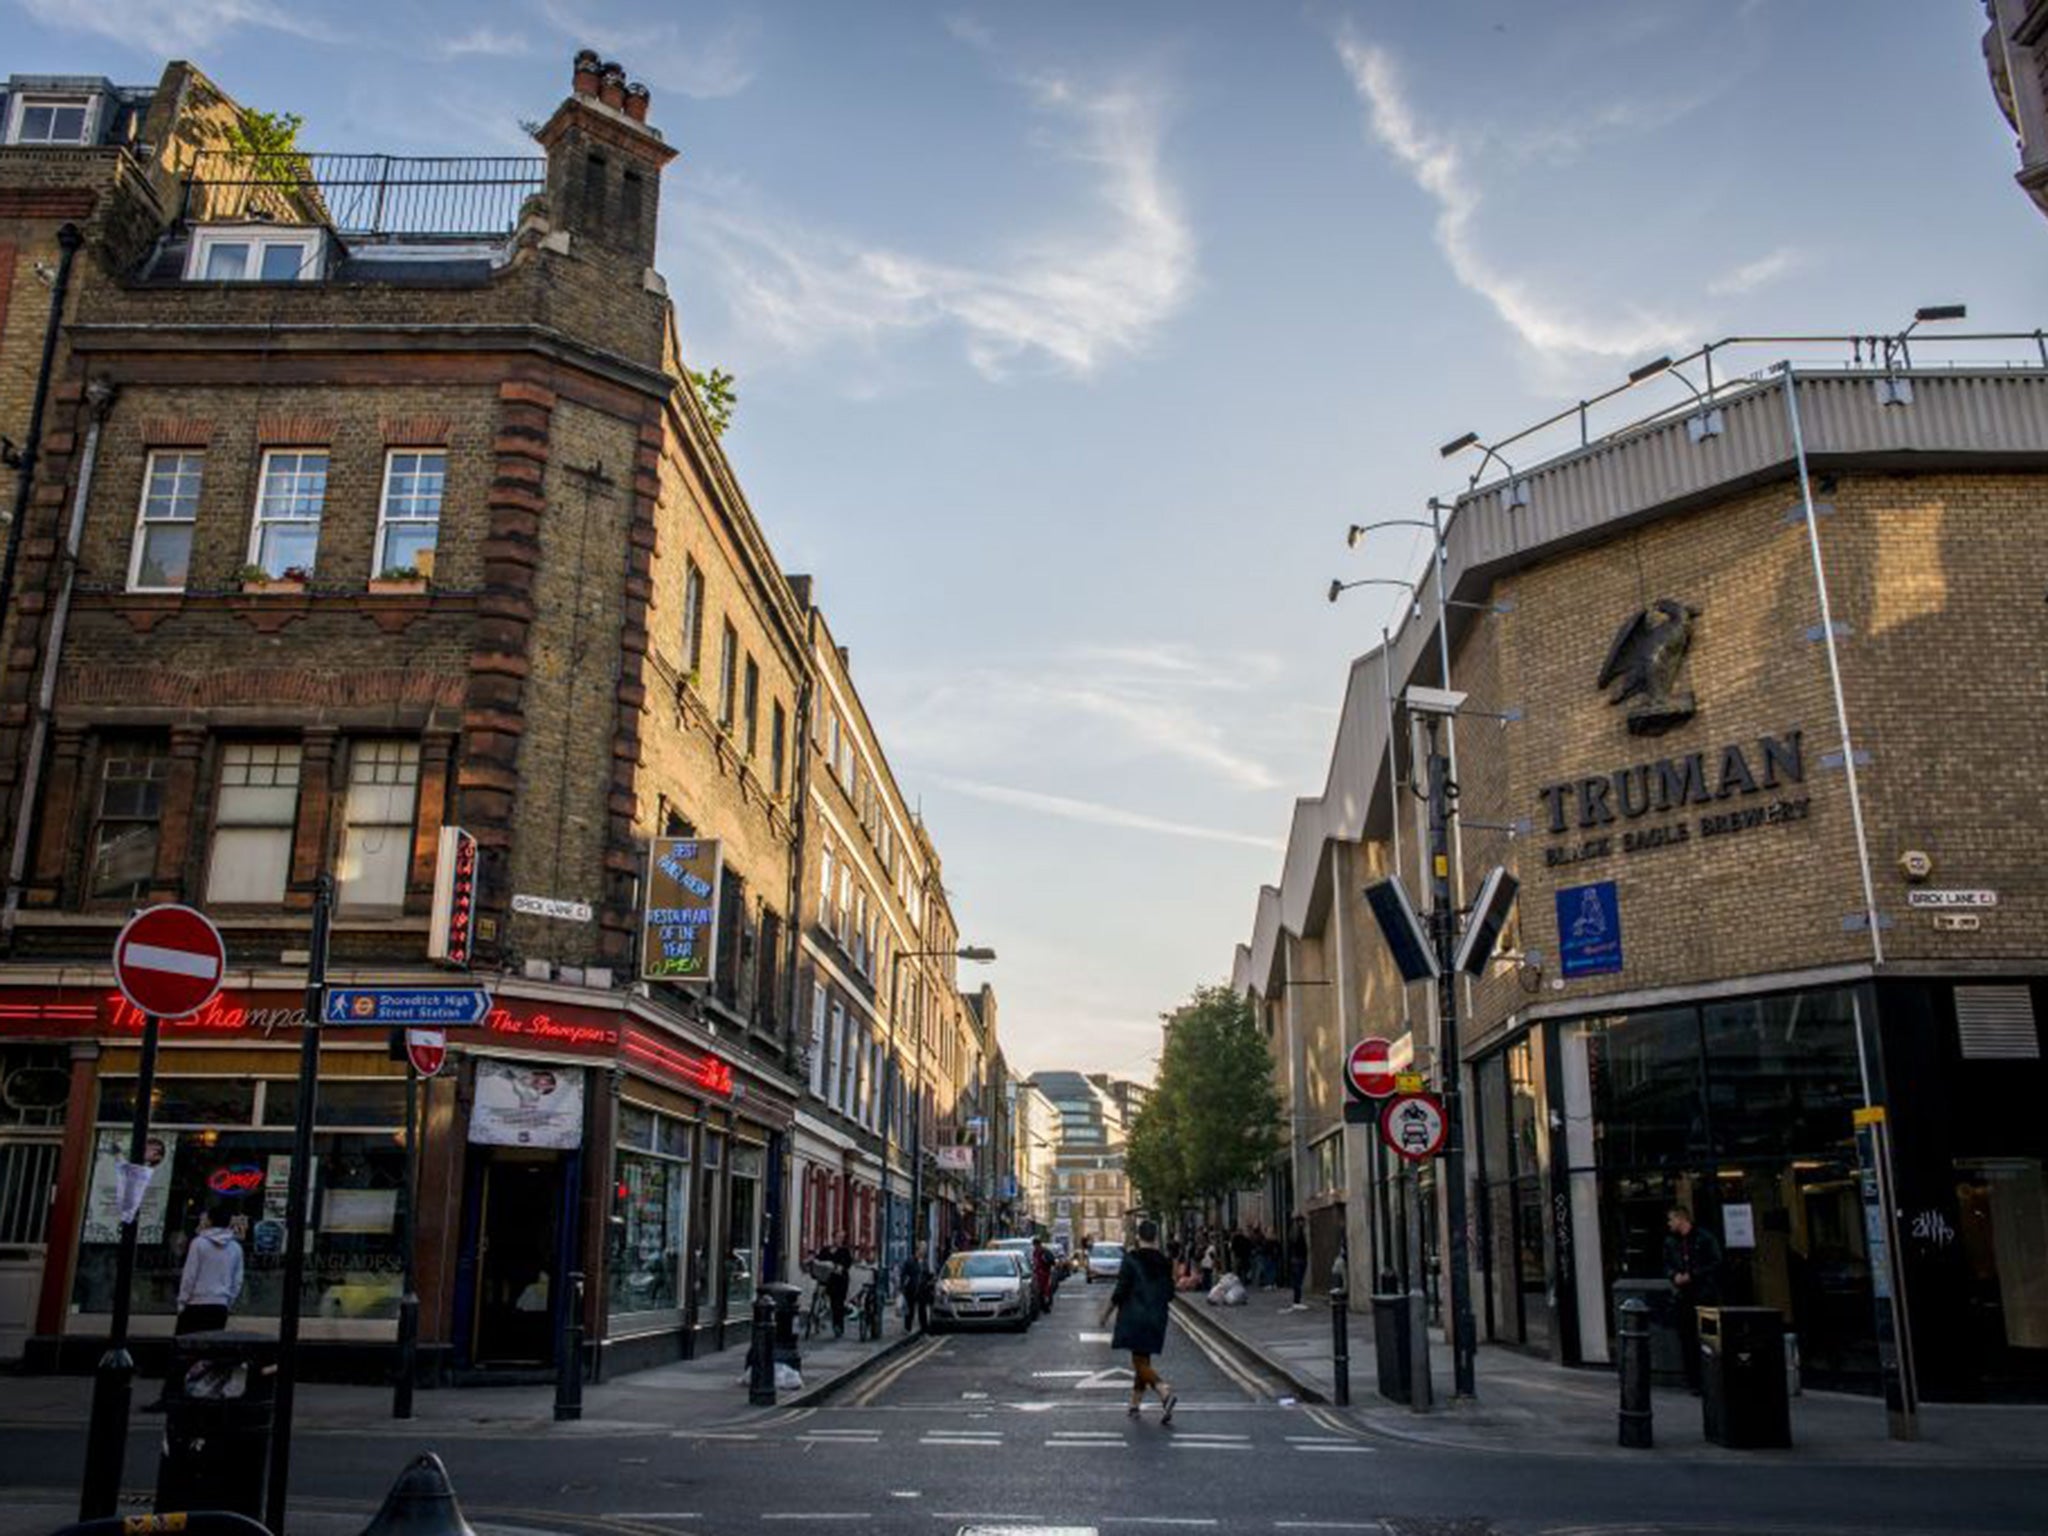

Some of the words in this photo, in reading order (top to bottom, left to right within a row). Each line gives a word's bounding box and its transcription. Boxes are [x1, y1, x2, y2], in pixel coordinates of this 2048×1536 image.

[1539, 729, 1806, 835] TRUMAN
[1546, 840, 1612, 868] BLACK
[1624, 823, 1690, 853] EAGLE
[1701, 797, 1811, 838] BREWERY
[1912, 893, 1943, 904] BRICK
[1946, 893, 1977, 904] LANE
[659, 926, 673, 940] OF
[662, 942, 693, 957] YEAR
[379, 994, 441, 1006] Shoreditch
[445, 994, 470, 1008] High
[378, 1006, 414, 1018] Street
[418, 1007, 461, 1019] Station
[490, 1009, 521, 1032] The
